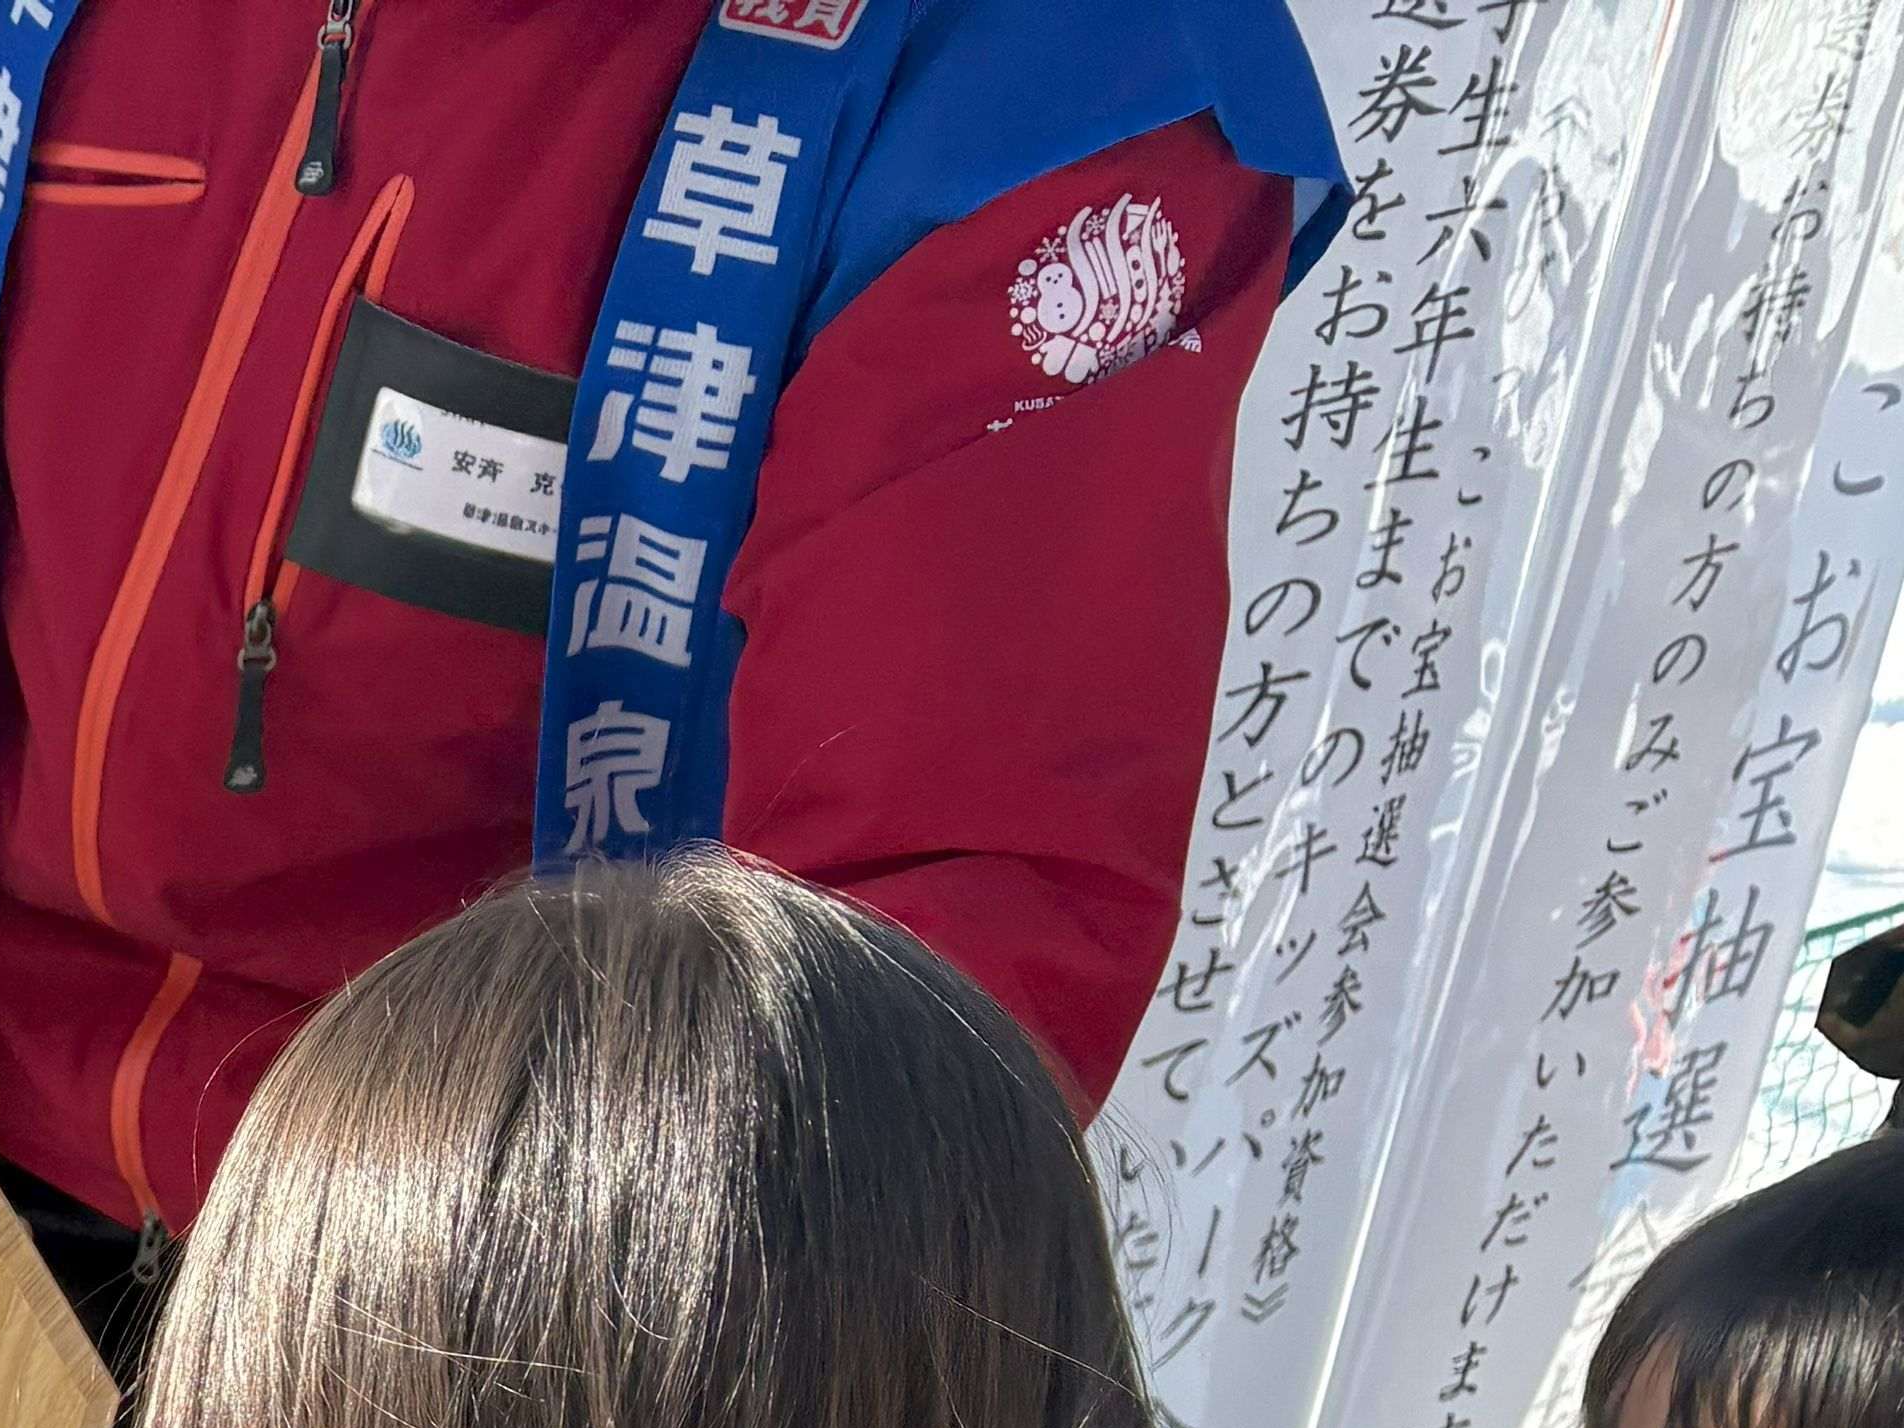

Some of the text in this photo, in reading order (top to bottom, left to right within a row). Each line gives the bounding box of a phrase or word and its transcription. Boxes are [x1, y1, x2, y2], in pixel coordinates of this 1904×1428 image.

[567, 104, 800, 860] 草津温泉
[1112, 0, 1468, 1310] 券をお持ちの方とさせていた
